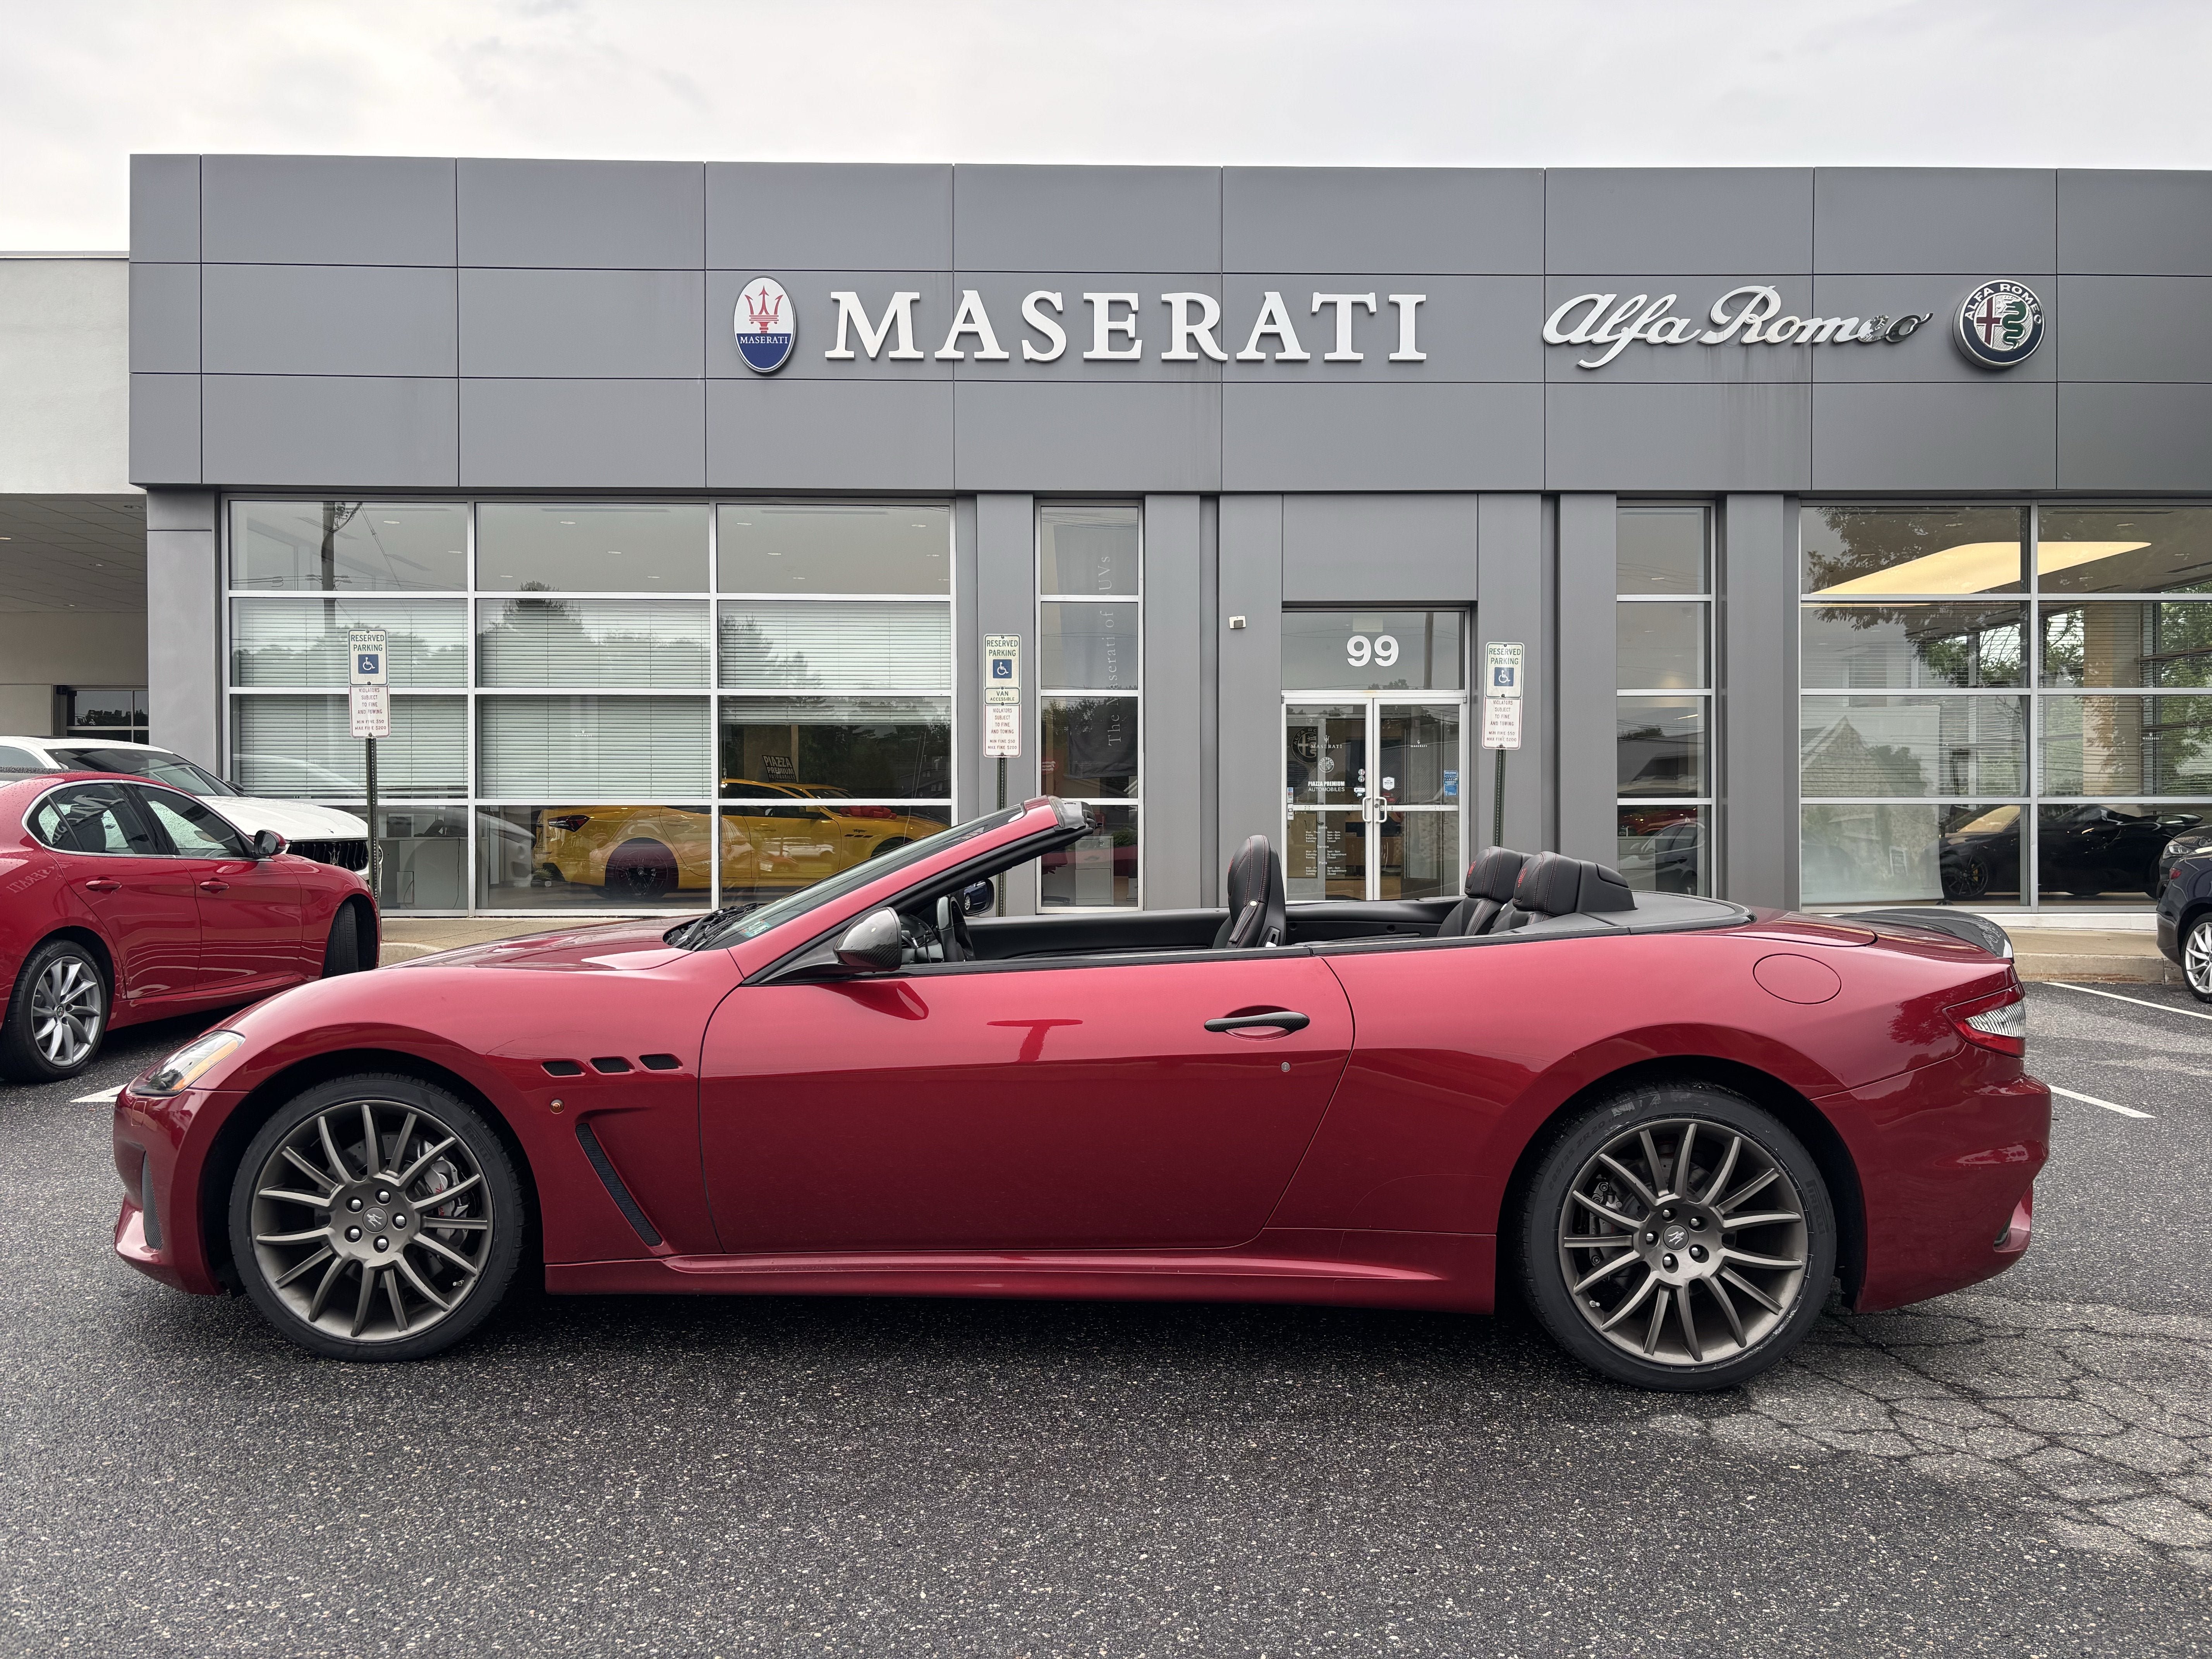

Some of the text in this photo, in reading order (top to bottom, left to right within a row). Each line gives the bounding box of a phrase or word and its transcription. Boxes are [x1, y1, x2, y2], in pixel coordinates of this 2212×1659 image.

[1965, 283, 2042, 324] ALFA ROMEO
[740, 336, 788, 344] MASERATI
[824, 290, 1428, 362] MASERATI
[1542, 285, 1934, 369] Alfa Romeo
[1098, 556, 1112, 595] UVs
[1100, 611, 1114, 628] of
[1346, 635, 1399, 667] 99
[1107, 714, 1121, 746] The
[1293, 730, 1305, 745] ALFA
[763, 756, 792, 768] PIAZZA
[461, 1122, 495, 1163] PIRELLI
[1805, 1179, 1829, 1235] PIRELLI
